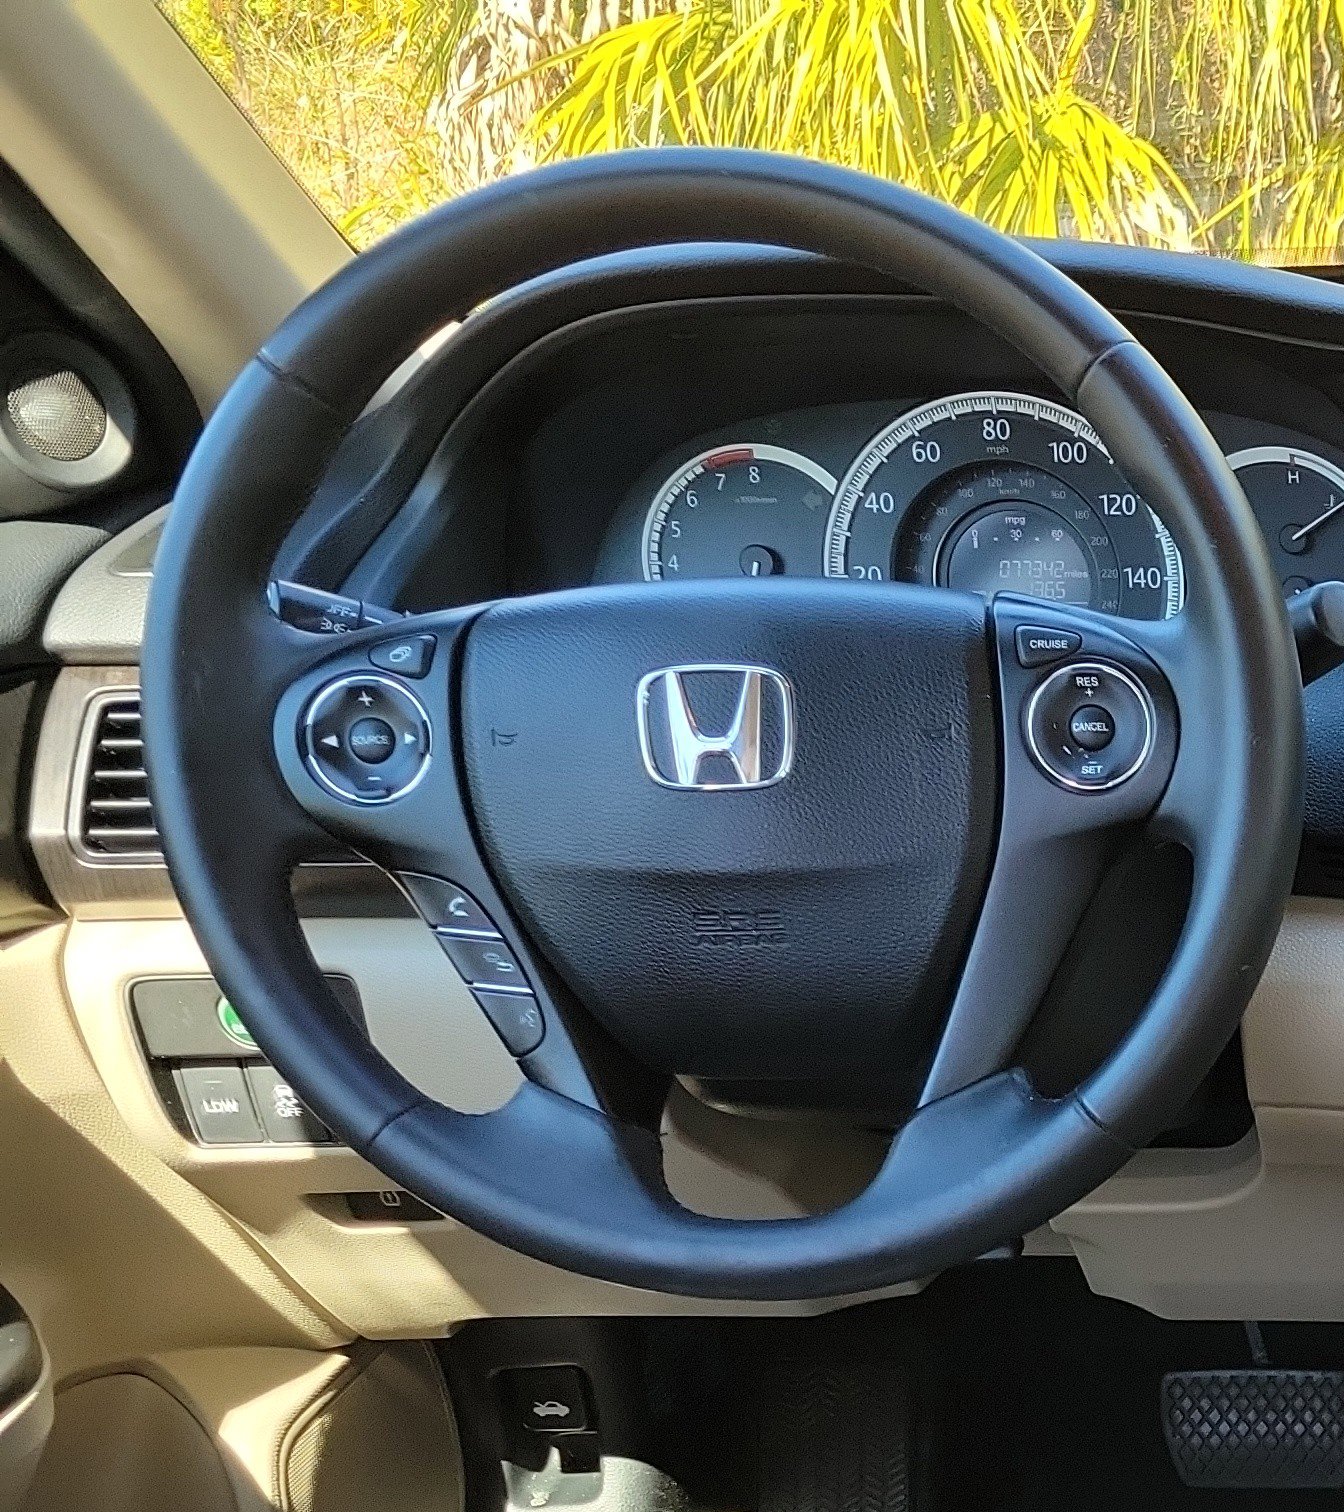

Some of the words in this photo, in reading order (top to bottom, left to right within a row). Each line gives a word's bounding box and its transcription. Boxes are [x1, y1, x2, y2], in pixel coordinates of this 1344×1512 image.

[982, 419, 1010, 441] 80
[912, 441, 941, 463] 60
[987, 445, 1009, 455] mph
[1048, 441, 1087, 464] 100
[749, 466, 760, 483] 8
[1288, 471, 1299, 483] H
[715, 473, 726, 491] 7
[987, 479, 1002, 488] 120
[1020, 479, 1035, 488] 140
[686, 490, 698, 508] 6
[864, 492, 894, 514] 40
[1099, 493, 1136, 516] 120
[1005, 517, 1025, 526] mpg
[1075, 510, 1089, 520] 180
[671, 521, 681, 538] 5
[1090, 536, 1108, 546] 200
[668, 555, 679, 571] 4
[1000, 561, 1064, 578] 077342
[1101, 569, 1118, 578] 220
[1123, 567, 1161, 590] 140
[1030, 639, 1068, 649] CRUISE
[1076, 676, 1098, 687] RES
[1073, 722, 1109, 732] CANCEL
[1081, 765, 1102, 774] SET
